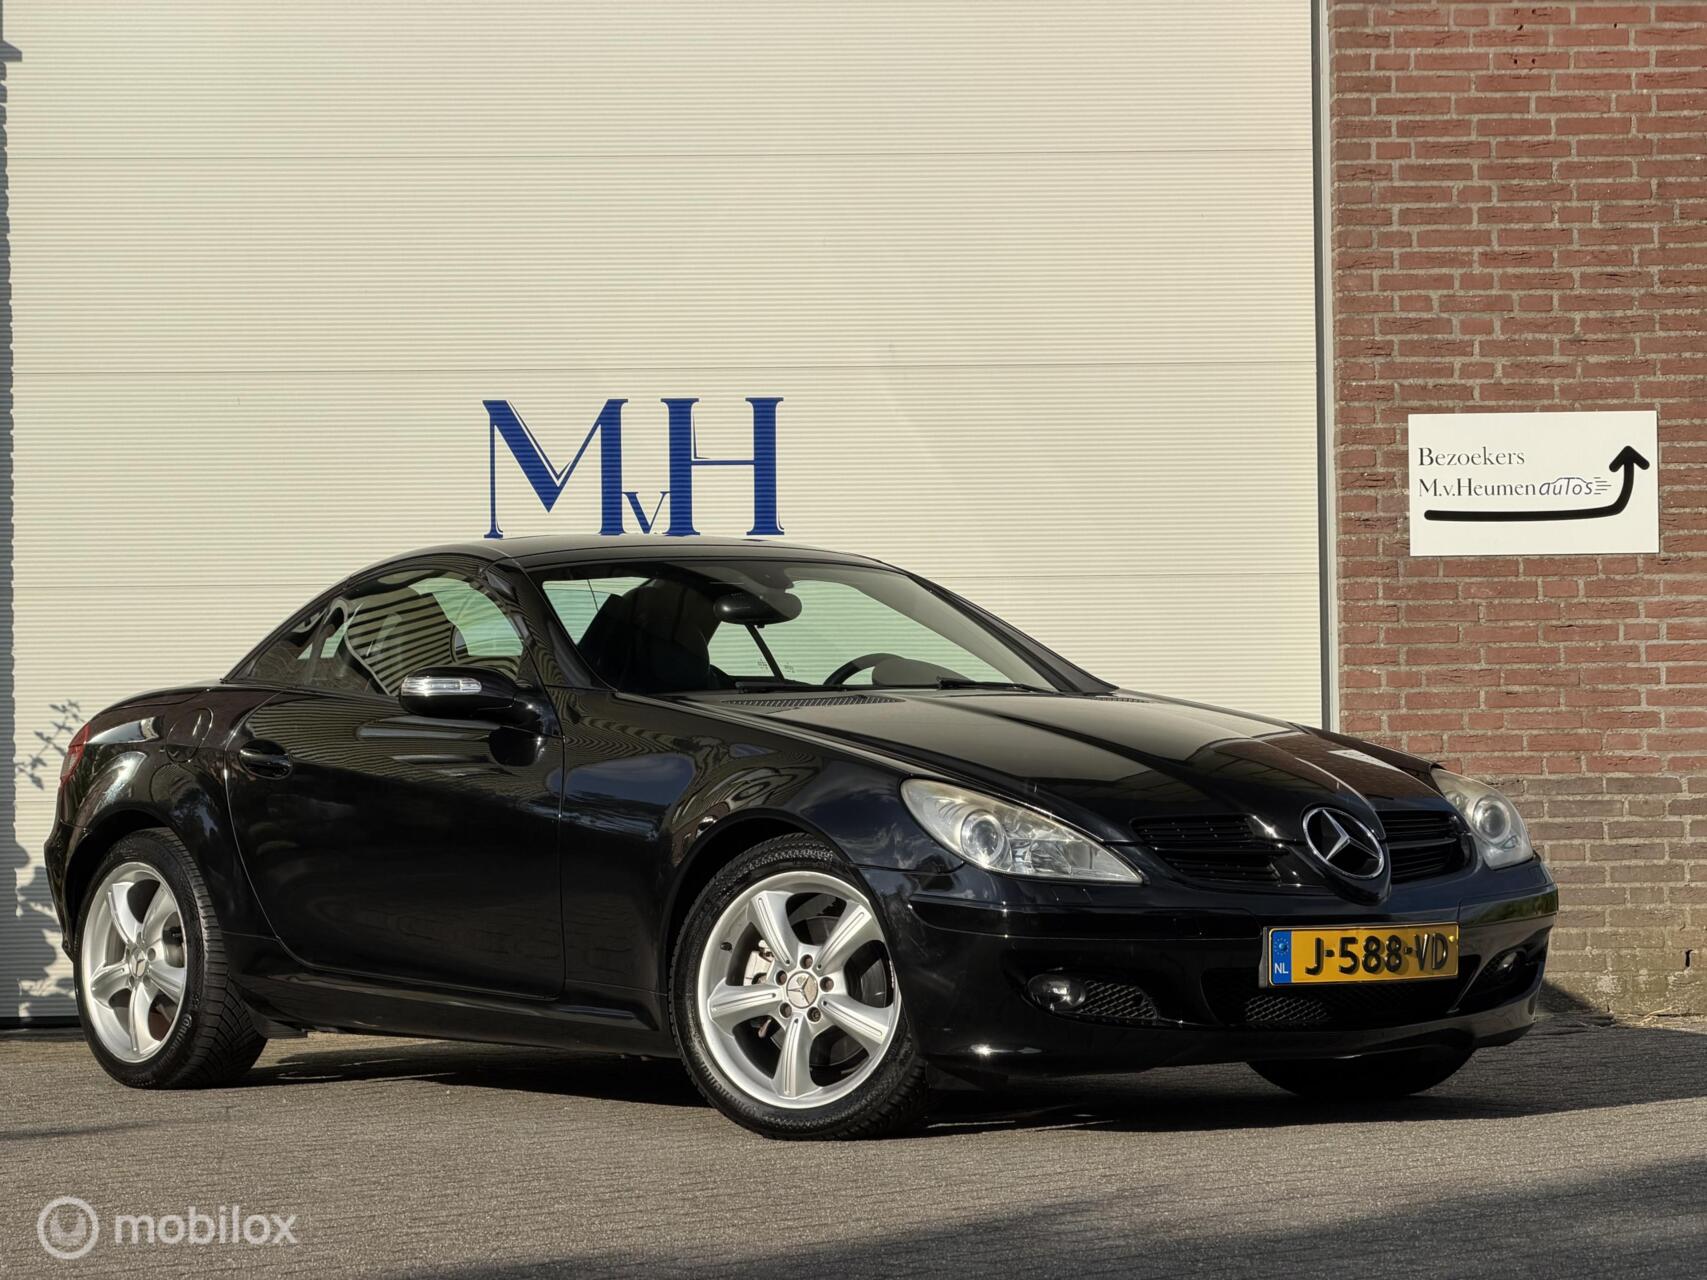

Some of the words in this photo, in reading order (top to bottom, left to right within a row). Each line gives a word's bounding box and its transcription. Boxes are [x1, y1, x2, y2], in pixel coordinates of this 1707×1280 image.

[1418, 446, 1525, 466] Bezoekers
[1304, 933, 1449, 976] J-588-VD
[1274, 963, 1289, 974] NL
